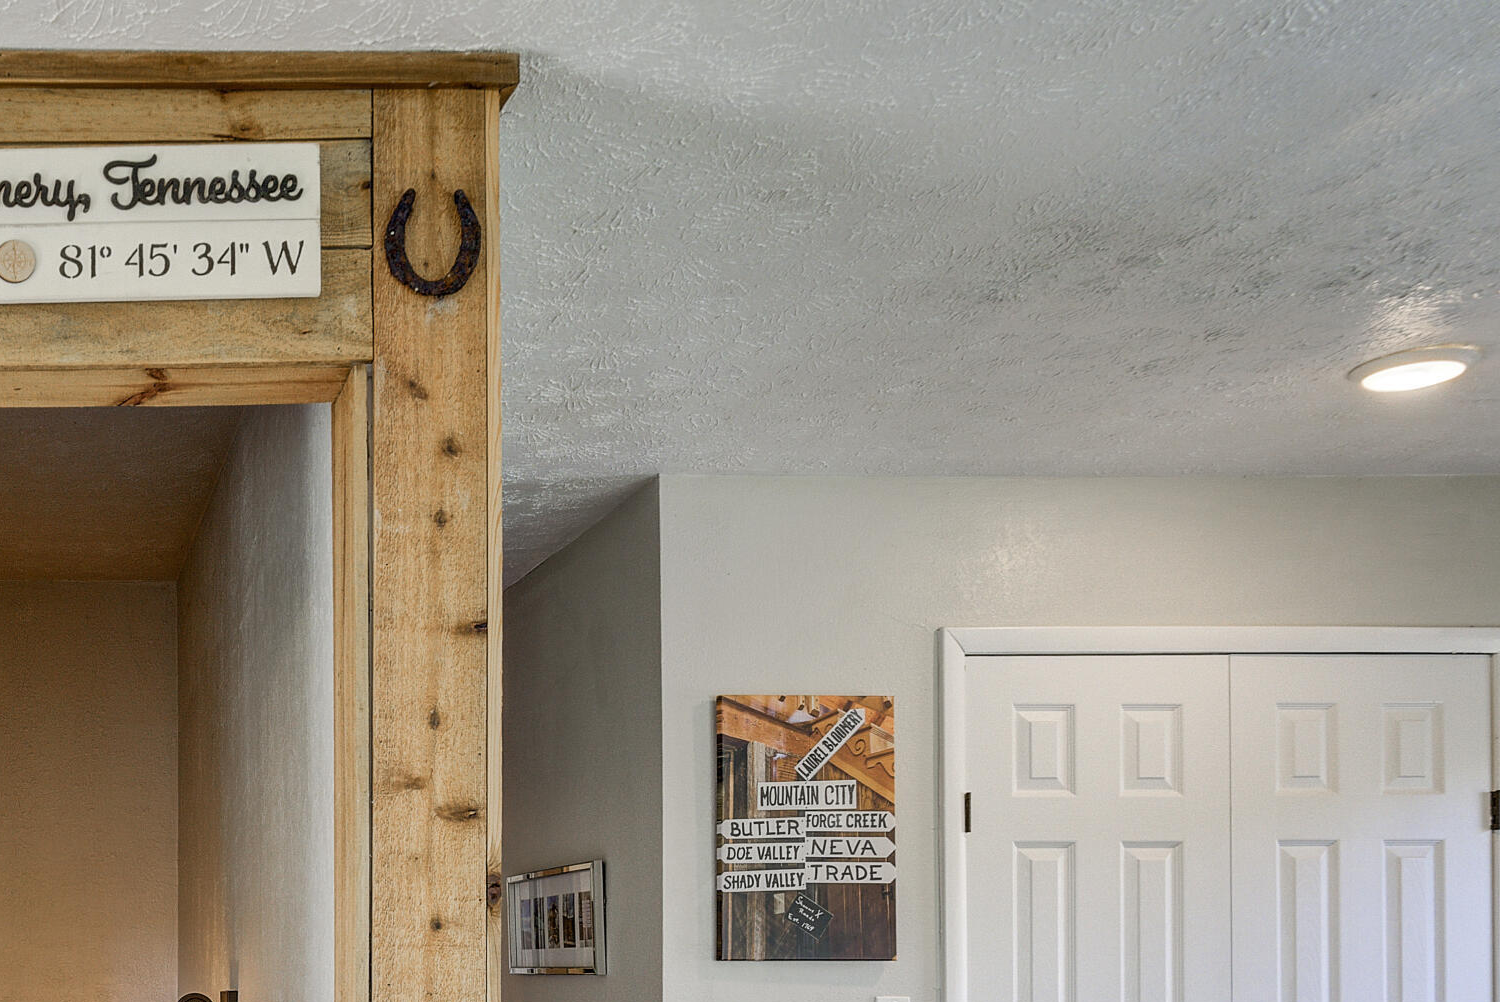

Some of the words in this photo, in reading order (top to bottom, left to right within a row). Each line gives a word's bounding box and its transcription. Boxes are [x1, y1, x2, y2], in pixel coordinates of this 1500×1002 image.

[102, 153, 304, 211] Tennessee
[124, 243, 178, 278] 45'
[191, 241, 250, 276] 34"
[262, 240, 304, 276] W
[797, 746, 829, 778] LAUREL
[759, 785, 819, 807] MOUNTAIN
[824, 783, 856, 806] CITY
[730, 819, 800, 837] BUTLER
[806, 813, 843, 829] FORGE
[845, 813, 888, 829] CREEK
[726, 846, 753, 861] DOE
[756, 845, 800, 861] VALLEY
[811, 839, 878, 856] NEVA
[722, 873, 762, 890] SHADY
[764, 871, 804, 889] VALLEY
[812, 864, 883, 882] TRADE
